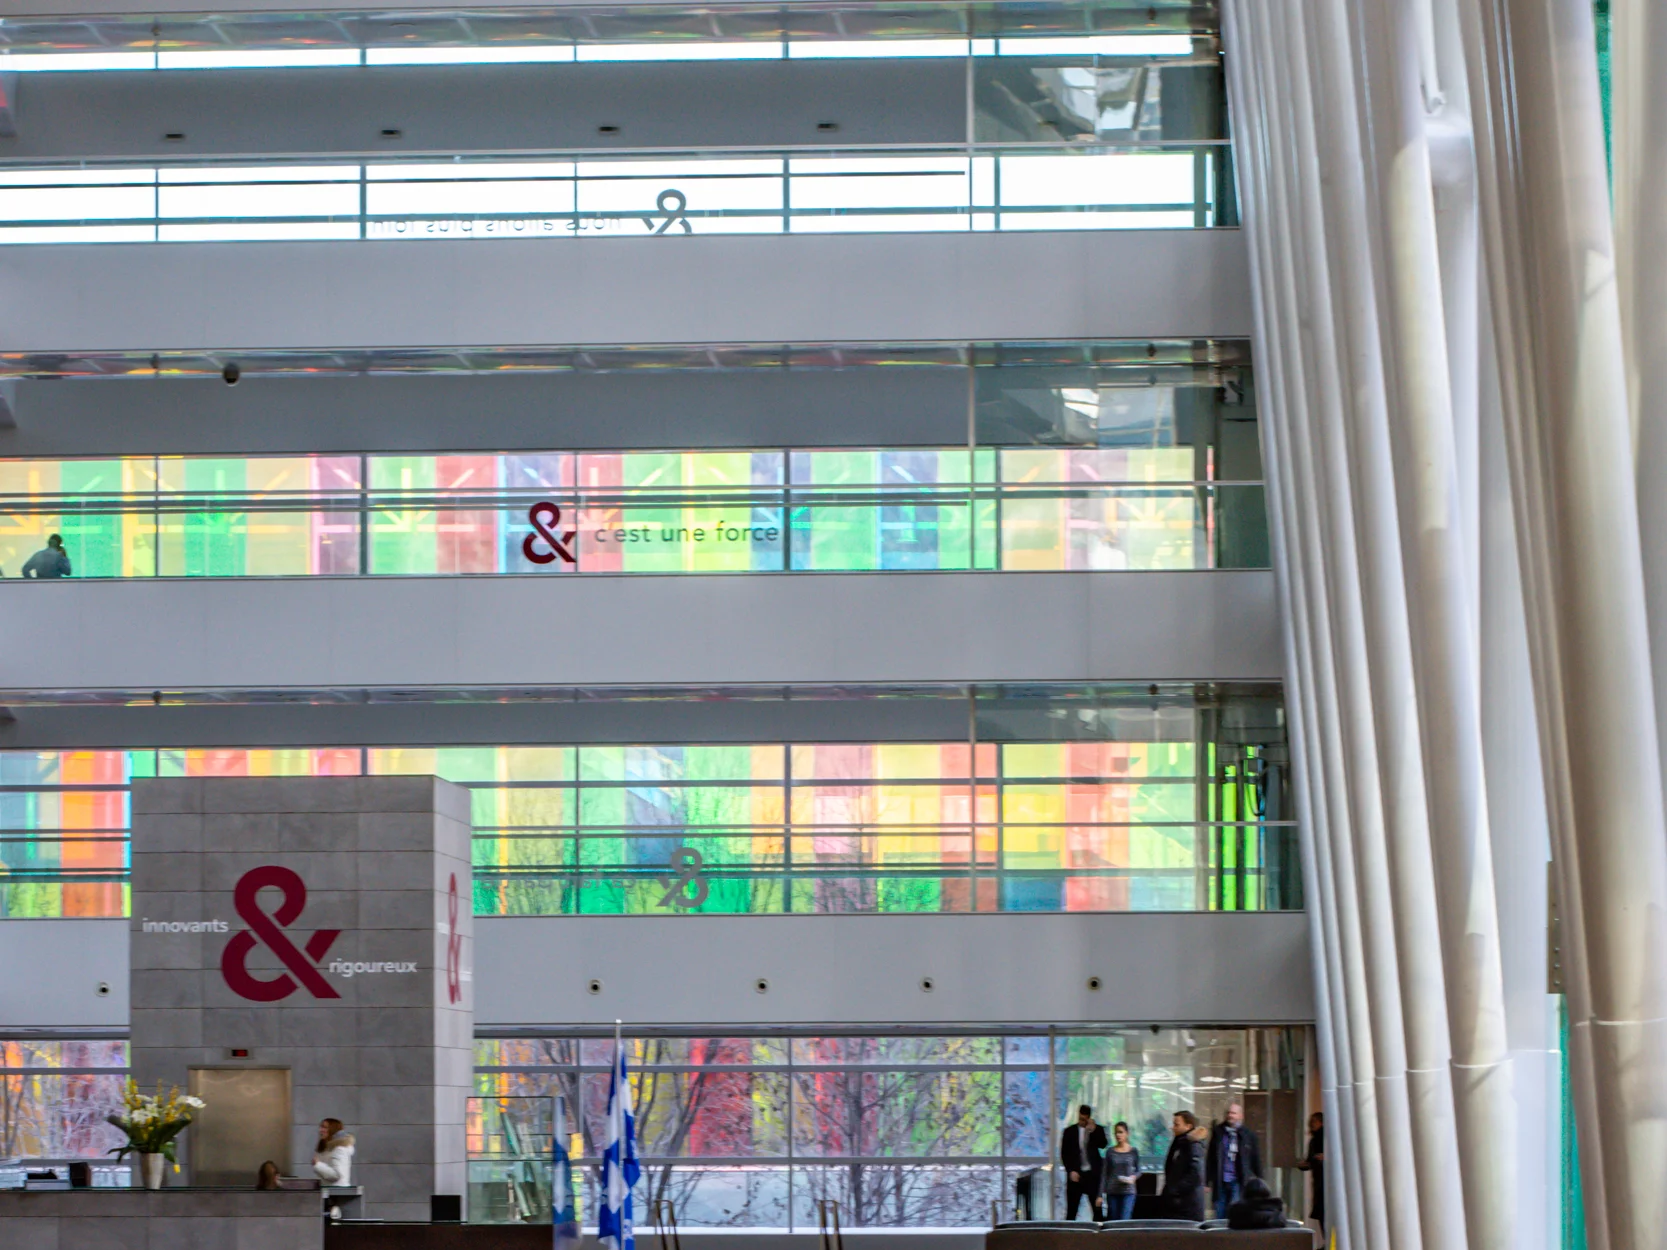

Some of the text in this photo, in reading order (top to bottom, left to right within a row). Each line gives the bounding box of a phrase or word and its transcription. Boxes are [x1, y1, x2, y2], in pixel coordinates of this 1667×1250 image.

[661, 526, 705, 542] une
[715, 519, 779, 542] force
[142, 918, 229, 934] innovants
[328, 957, 418, 978] rigoureux
